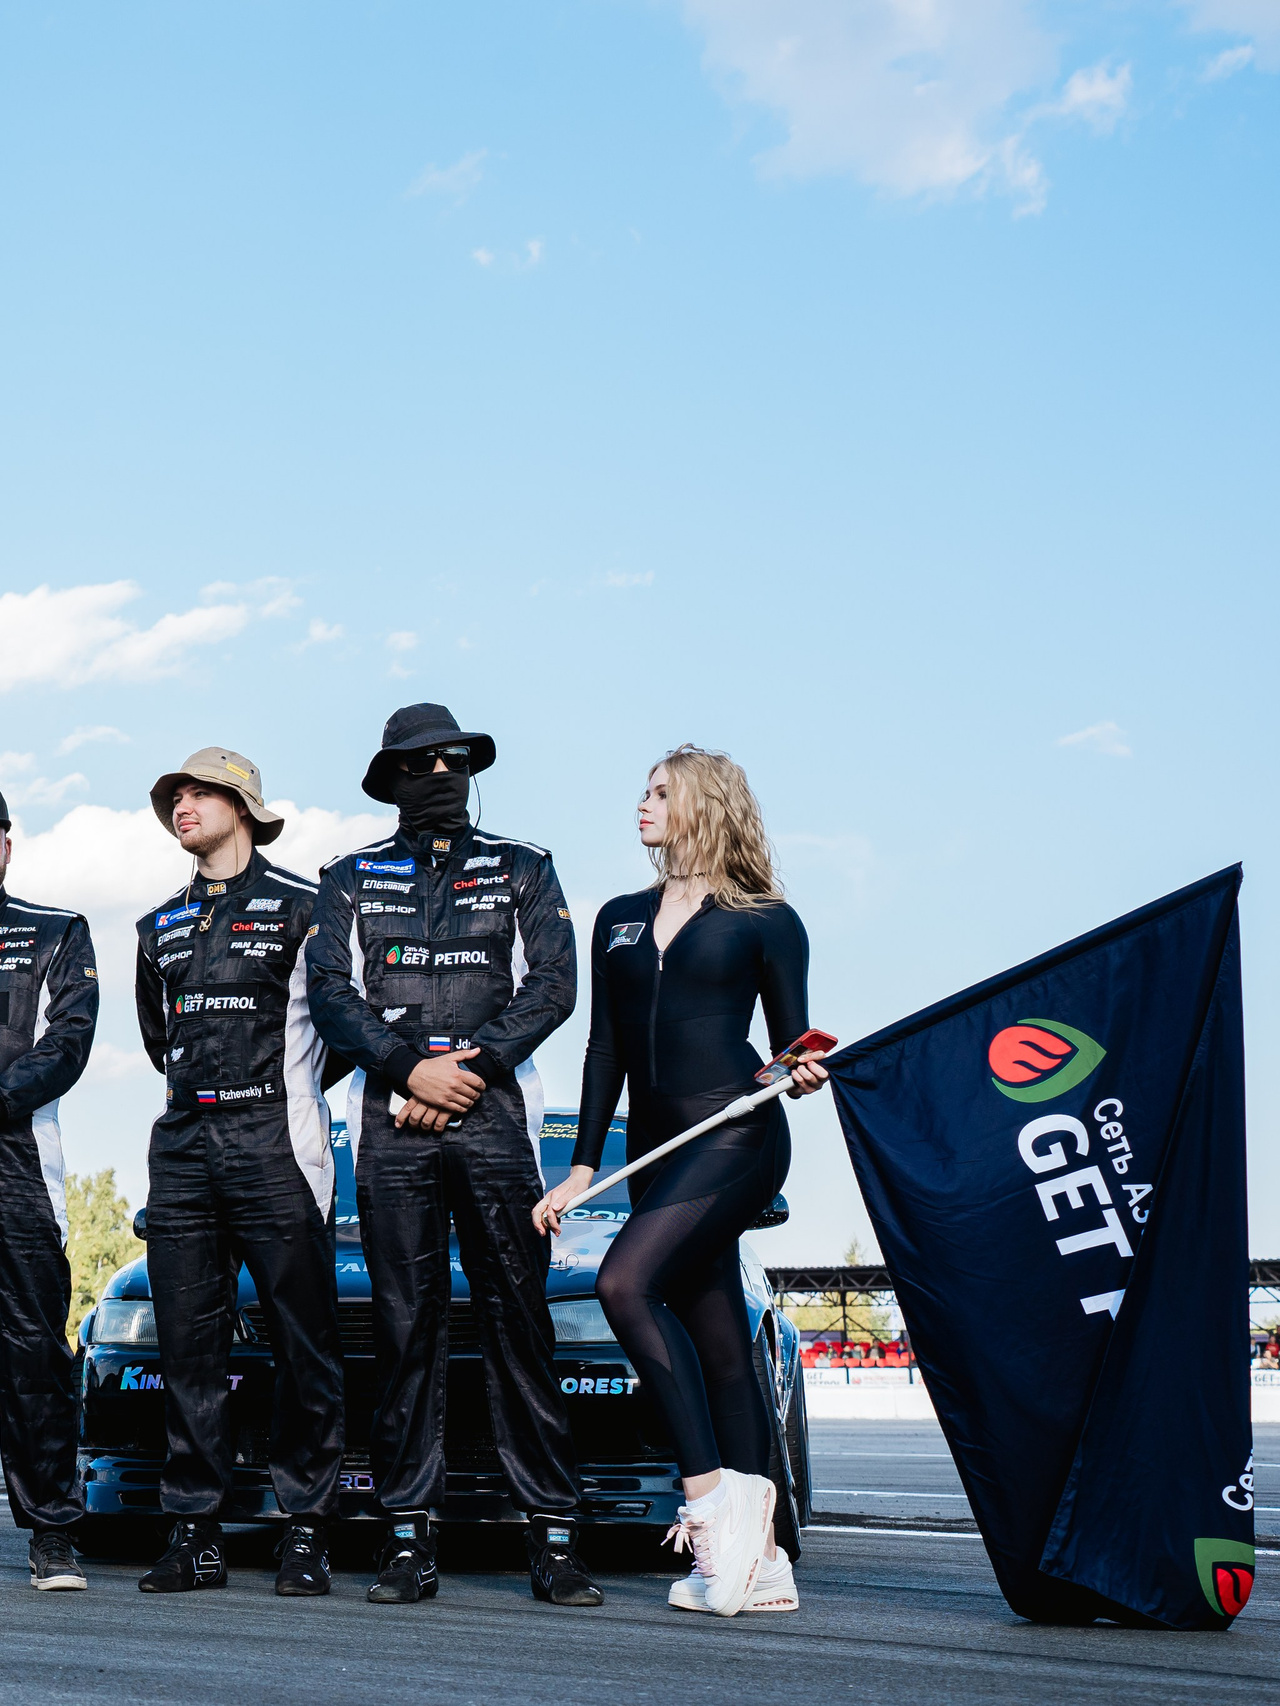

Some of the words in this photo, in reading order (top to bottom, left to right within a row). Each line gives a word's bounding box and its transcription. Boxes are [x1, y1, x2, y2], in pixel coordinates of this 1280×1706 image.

[433, 839, 450, 850] OMP
[208, 883, 226, 894] OMP
[455, 896, 477, 906] FAN
[471, 903, 495, 911] PRO
[230, 941, 251, 949] FAN
[243, 949, 266, 957] PRO
[401, 953, 429, 965] GET
[434, 951, 489, 966] PETROL
[184, 1000, 204, 1013] GET
[205, 997, 257, 1010] PETROL
[219, 1085, 262, 1101] Rzhevskiy
[1094, 1098, 1134, 1174] Сеть
[1018, 1114, 1134, 1257] GET
